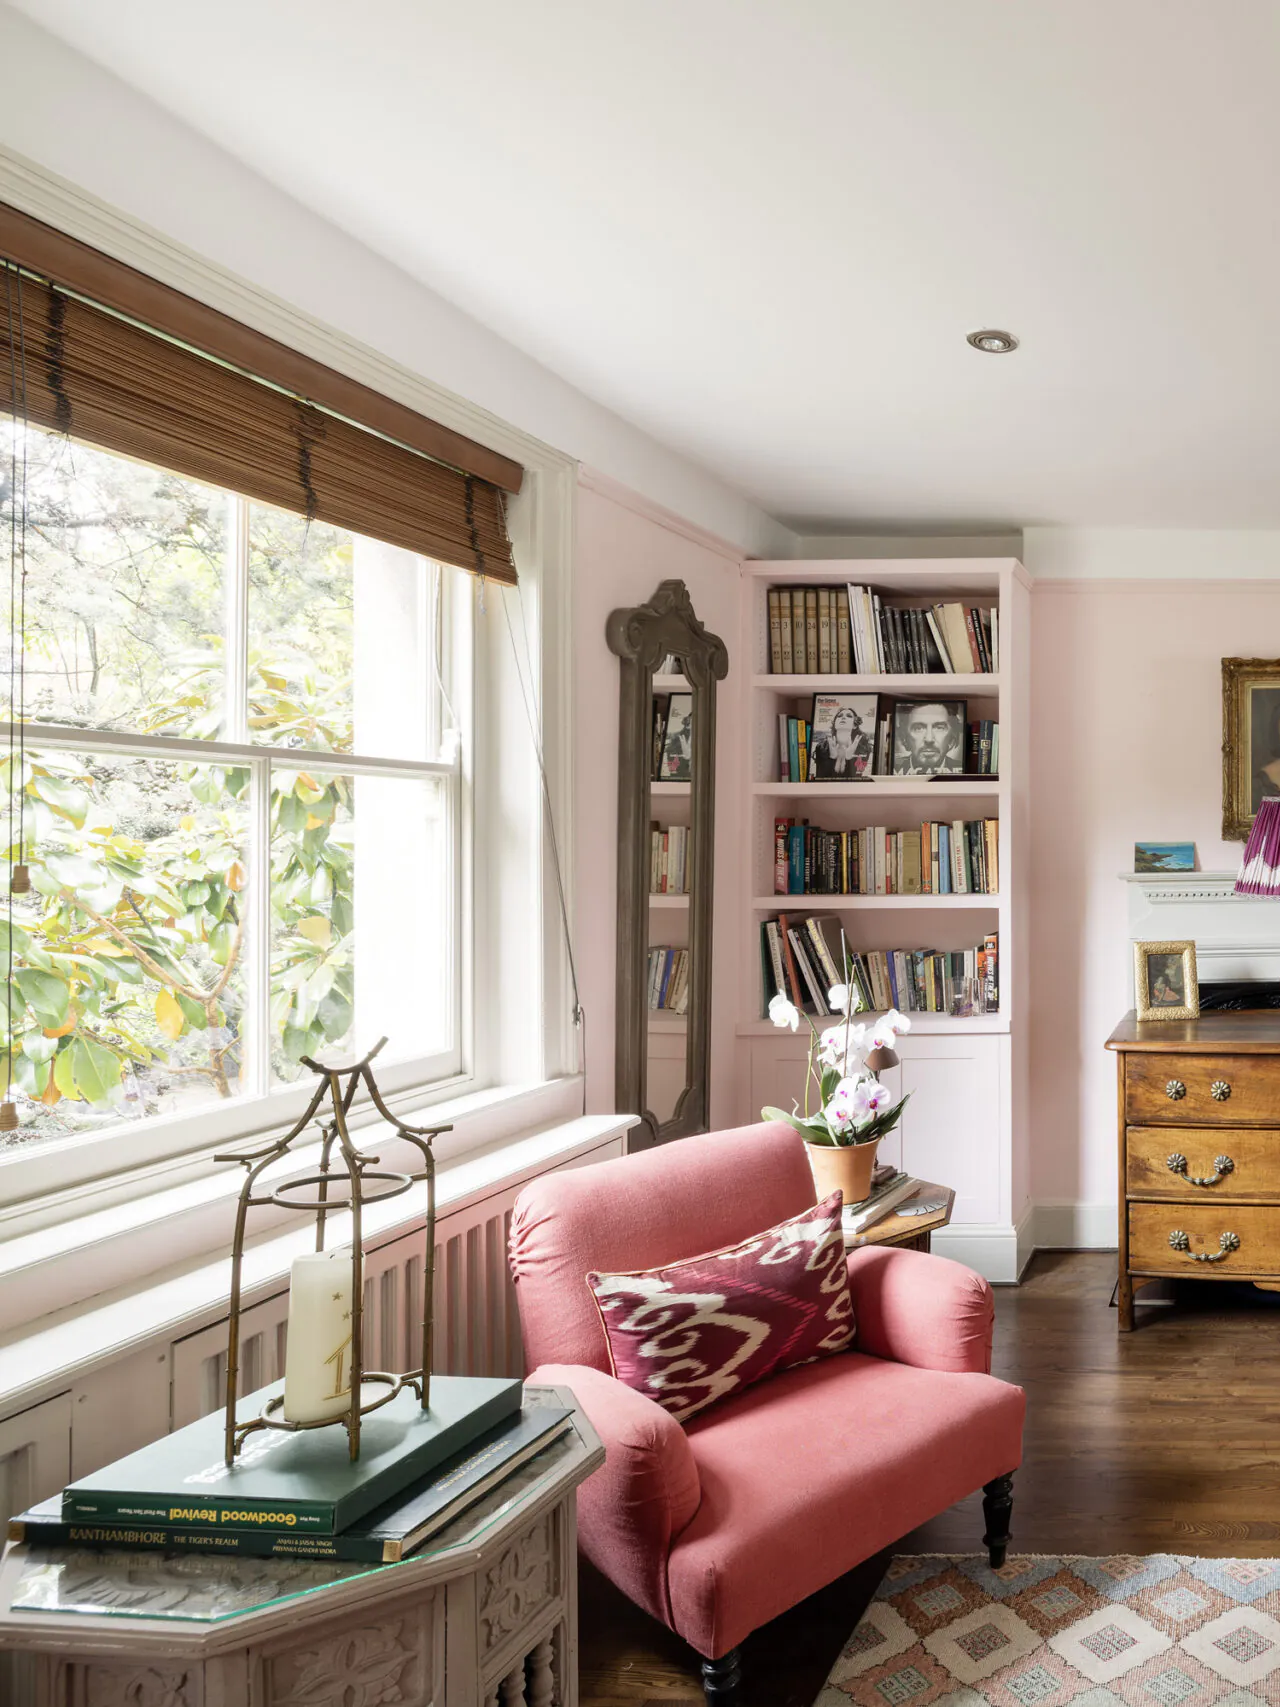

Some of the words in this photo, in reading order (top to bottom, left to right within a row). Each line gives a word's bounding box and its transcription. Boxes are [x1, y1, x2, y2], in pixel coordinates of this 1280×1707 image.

[807, 621, 816, 630] 24
[776, 839, 785, 859] MOVIES
[986, 956, 995, 975] MOVIES
[169, 1507, 217, 1522] Revival
[221, 1509, 297, 1526] Goodwood
[69, 1528, 167, 1545] RANTHAMBHORE
[174, 1535, 186, 1544] THE
[188, 1535, 214, 1545] TIGER'S
[215, 1537, 239, 1547] REALM
[272, 1545, 296, 1553] PRIYANKA
[297, 1546, 319, 1554] GANDHI
